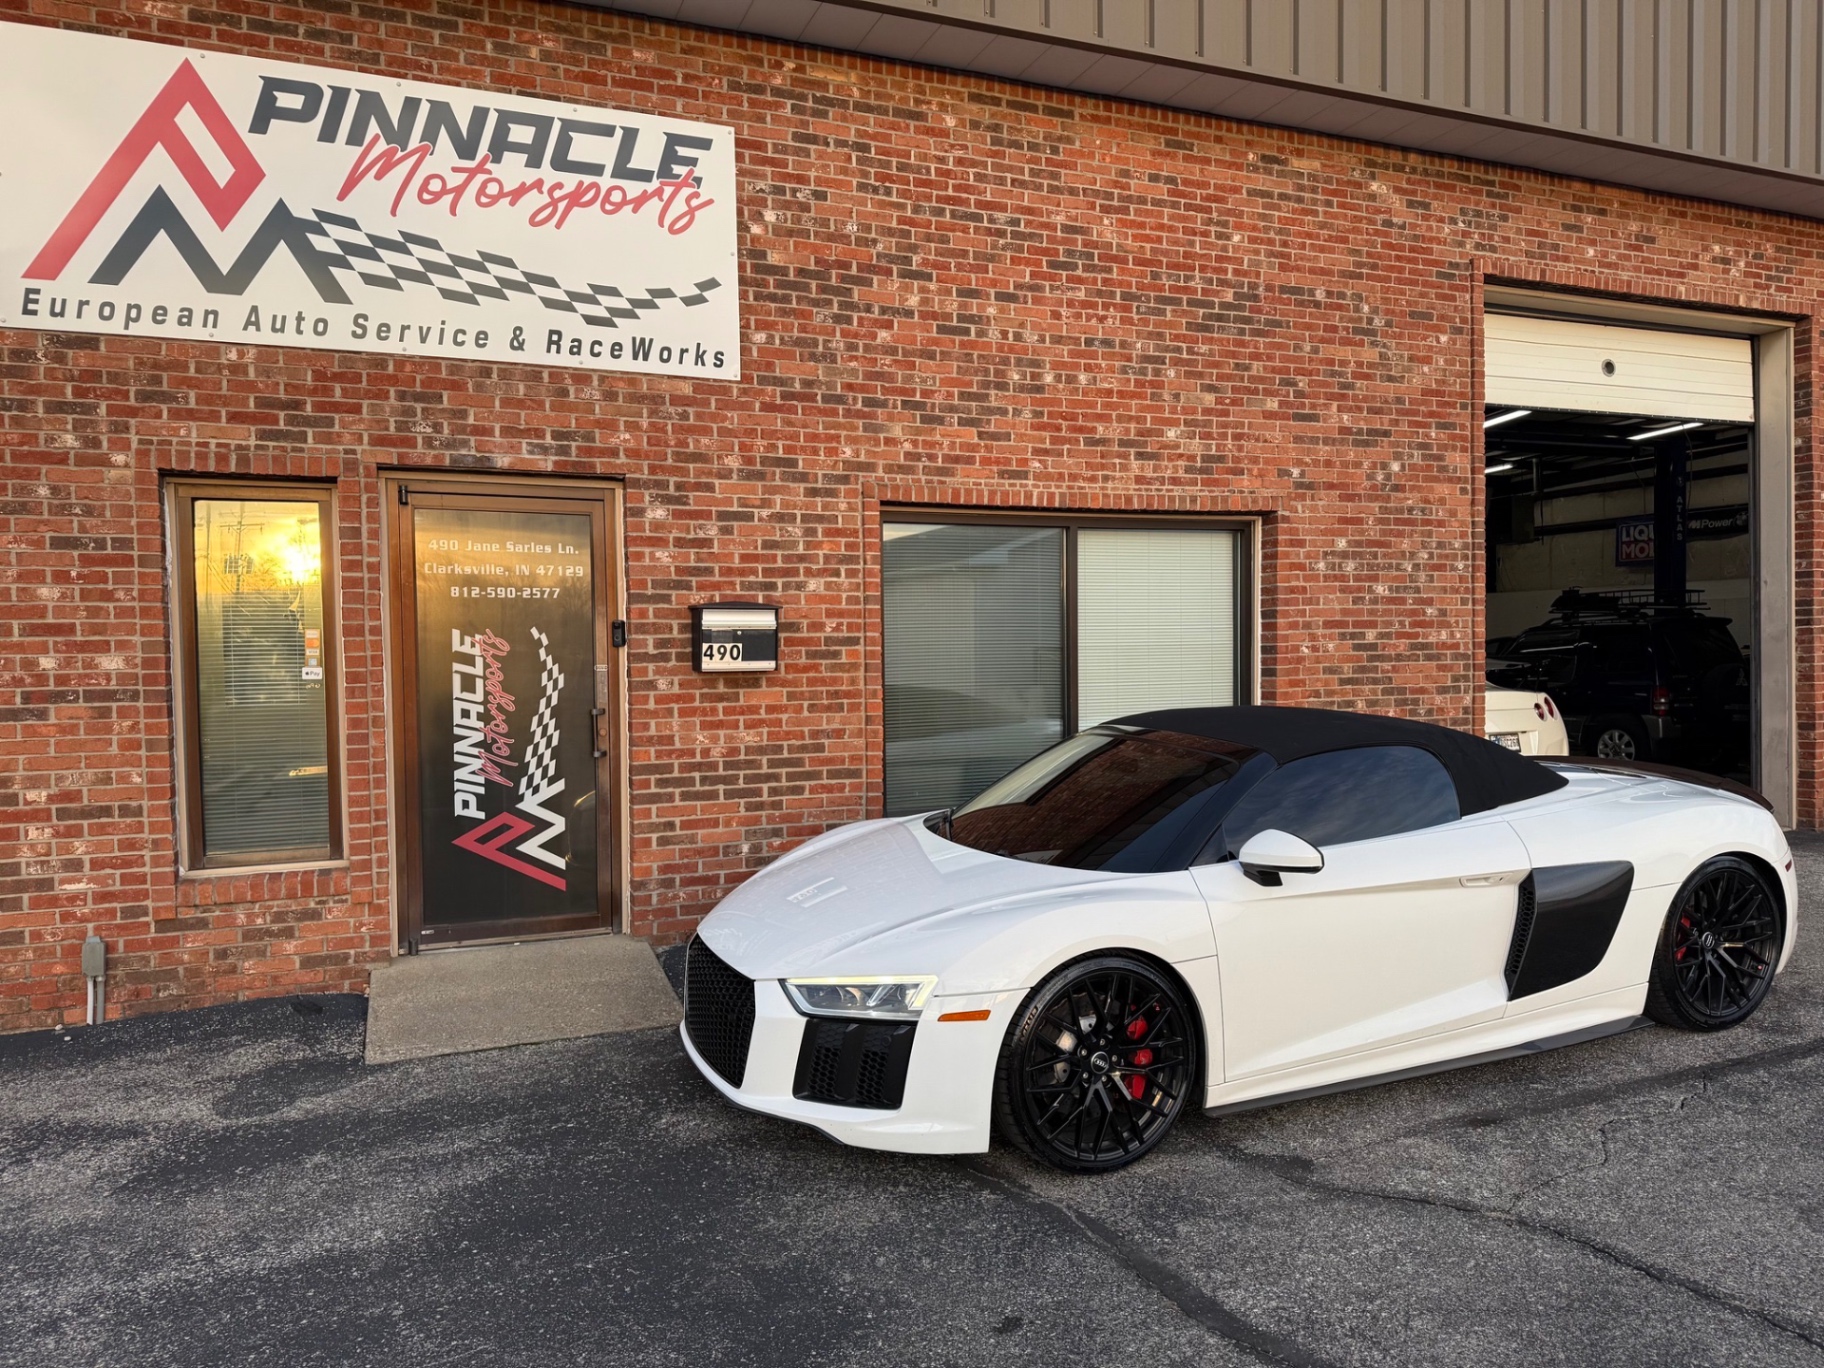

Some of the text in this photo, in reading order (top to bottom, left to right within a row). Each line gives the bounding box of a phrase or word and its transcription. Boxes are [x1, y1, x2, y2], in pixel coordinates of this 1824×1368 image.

[248, 75, 713, 190] PINNACLE
[336, 132, 715, 236] Motorsports
[21, 287, 725, 369] European Auto Service & RaceWorks
[428, 539, 579, 554] 490 Jane Sarles Ln.
[1675, 495, 1684, 541] ATLAS
[424, 562, 584, 577] Clarksville, IN 47129
[450, 586, 561, 599] 812-590-2577
[703, 644, 741, 661] 490
[452, 628, 486, 820] PINNACLE
[472, 628, 519, 788] Motorsports
